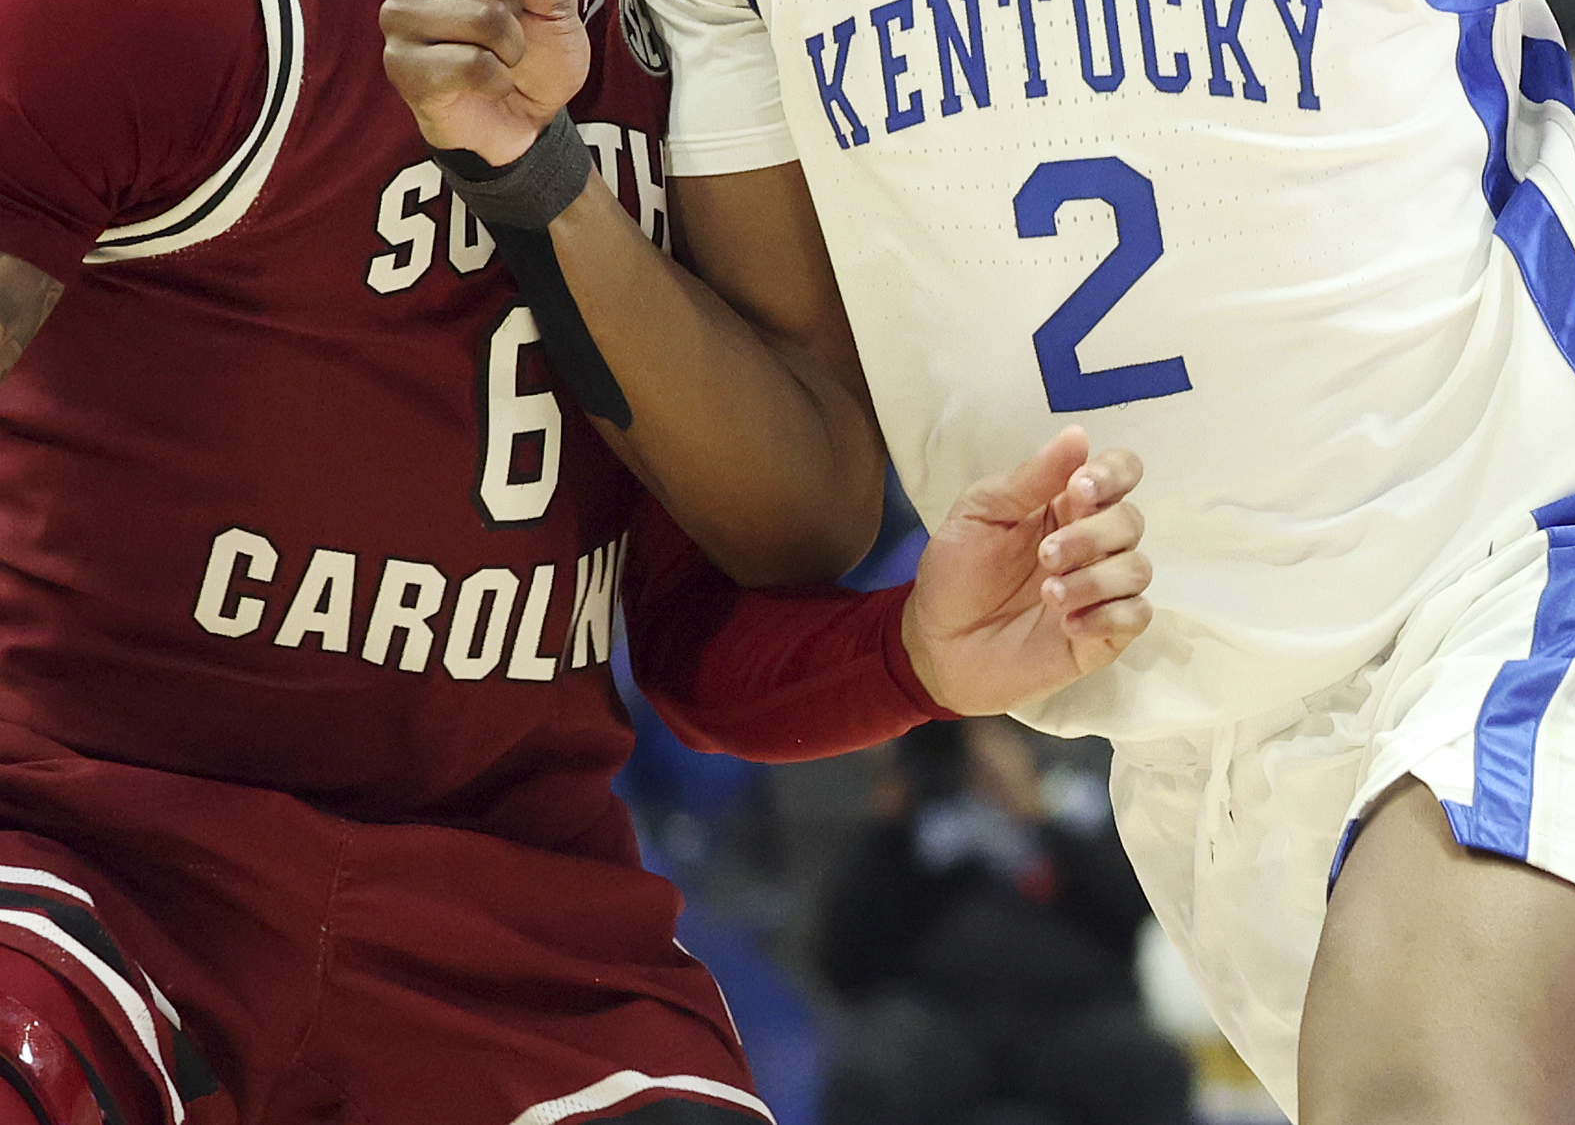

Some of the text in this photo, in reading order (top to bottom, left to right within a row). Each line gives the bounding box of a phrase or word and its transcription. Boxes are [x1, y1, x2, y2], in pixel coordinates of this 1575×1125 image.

[1012, 155, 1193, 413] 2
[480, 305, 562, 523] 6
[193, 527, 628, 682] CAROLIN
